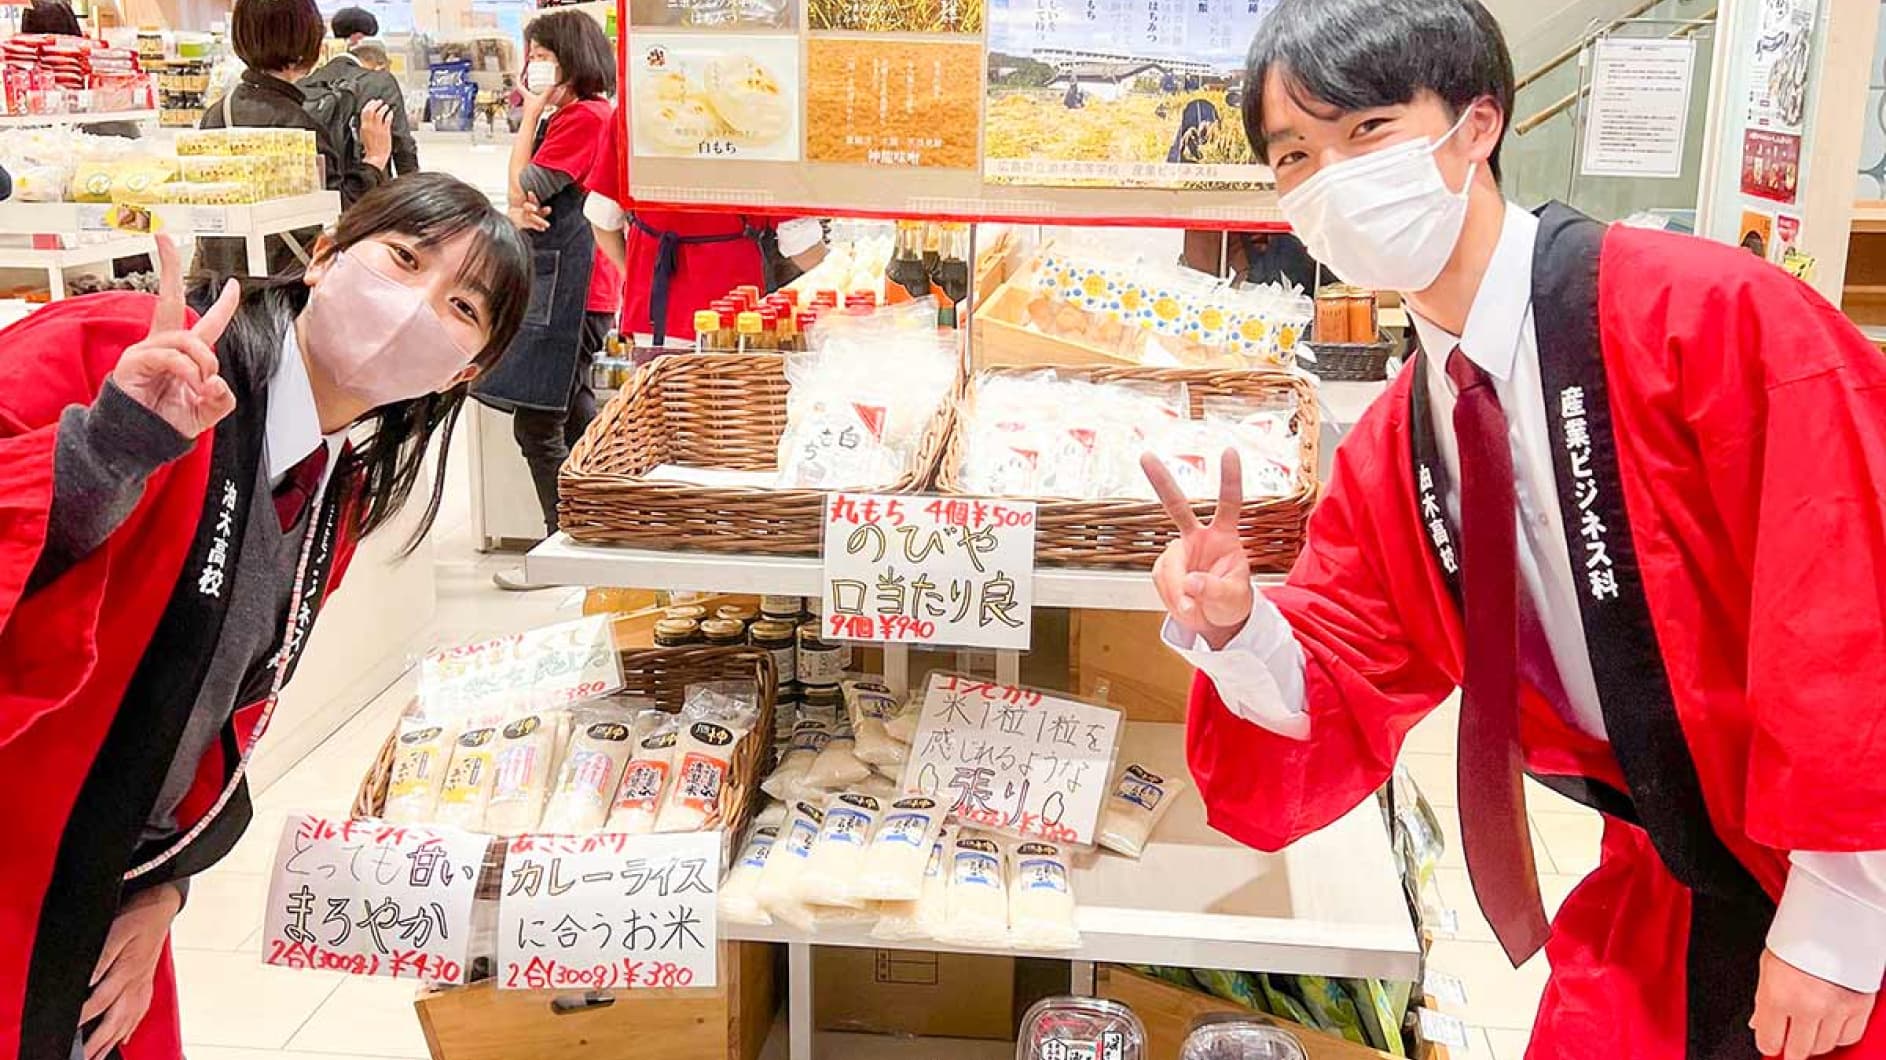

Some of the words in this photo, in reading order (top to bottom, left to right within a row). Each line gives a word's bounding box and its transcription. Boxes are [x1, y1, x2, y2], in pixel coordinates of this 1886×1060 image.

[698, 141, 737, 155] 白もち
[829, 495, 905, 527] 丸もち
[1561, 385, 1619, 601] 産業ビジネス科
[198, 479, 238, 598] 油木高校
[846, 522, 999, 573] のびや
[830, 565, 1024, 628] 口当たり良
[933, 693, 1106, 752] 米1粒1粒を
[920, 727, 1090, 794] 感じれるような
[947, 766, 1031, 826] 張り
[285, 829, 474, 887] とっても甘い
[506, 857, 714, 897] カレーライス
[284, 884, 449, 955] まろやか
[517, 903, 706, 951] に合うお米
